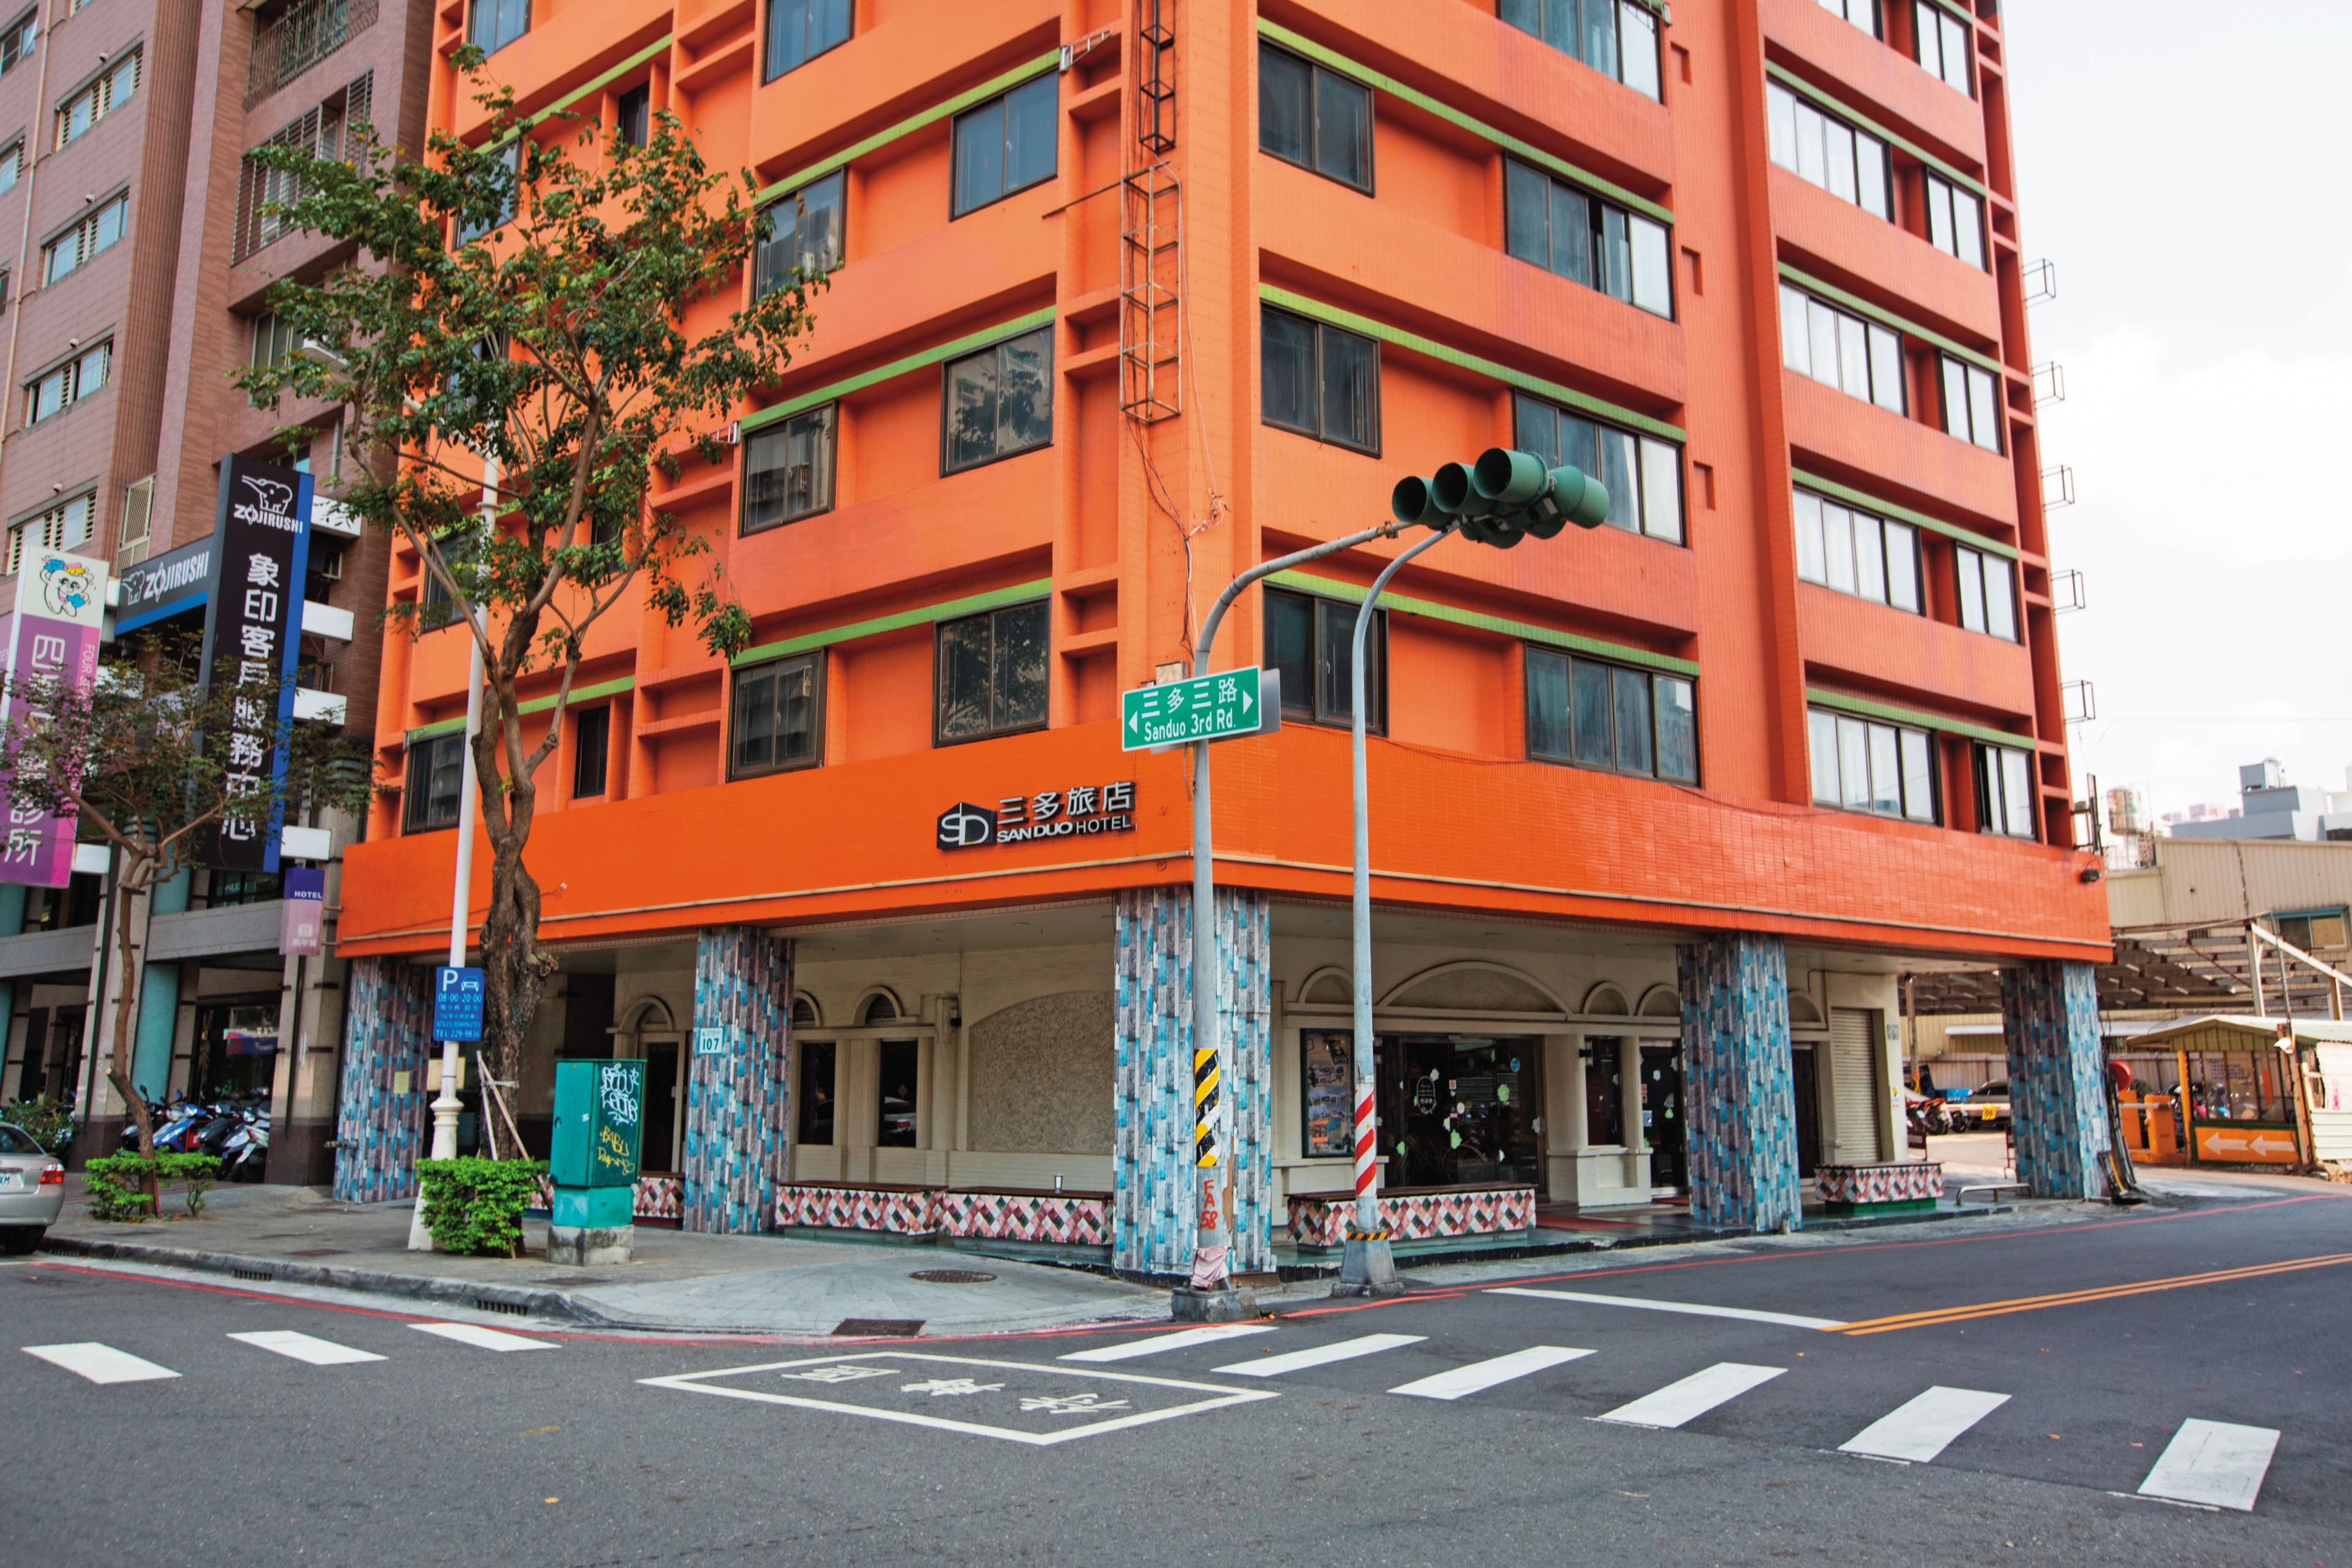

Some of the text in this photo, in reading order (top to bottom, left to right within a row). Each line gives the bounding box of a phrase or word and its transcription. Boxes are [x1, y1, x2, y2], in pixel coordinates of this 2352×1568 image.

[233, 503, 304, 534] ZOJIRUSHI
[143, 551, 209, 603] ZOJIRUSHI
[81, 643, 96, 674] FOUR
[1141, 676, 1238, 719] 三多三路
[1144, 707, 1237, 742] Sanduo 3rd Rd.
[997, 781, 1132, 824] 三多旅店
[1076, 814, 1131, 834] HOTEL
[294, 890, 323, 899] HOTEL
[442, 969, 459, 992] P
[703, 1038, 720, 1051] 107
